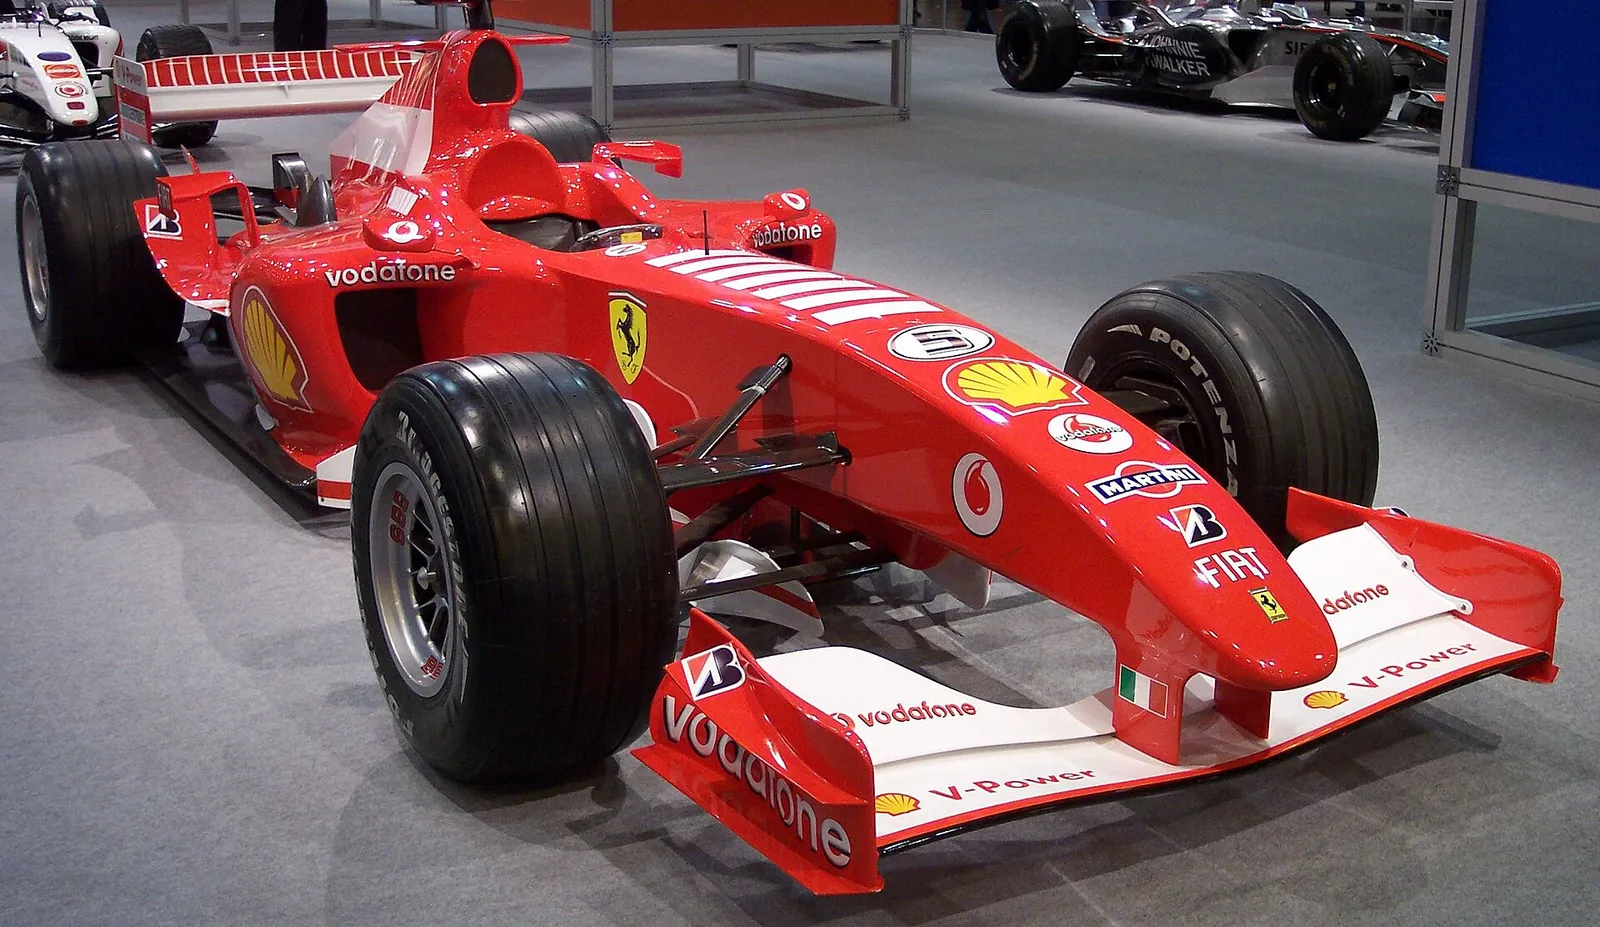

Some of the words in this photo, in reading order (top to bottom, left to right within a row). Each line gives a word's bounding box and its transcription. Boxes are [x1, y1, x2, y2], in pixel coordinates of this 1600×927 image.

[752, 221, 823, 248] vodafone
[324, 260, 456, 288] vodafone
[1149, 326, 1239, 497] POTENZA
[1056, 426, 1124, 442] vodafone
[1104, 467, 1196, 498] MARTINI
[1193, 547, 1271, 590] FIAT
[1348, 641, 1478, 690] V-Power
[857, 700, 978, 728] vodafone
[662, 694, 852, 868] vodafone
[929, 769, 1098, 802] V-Power
